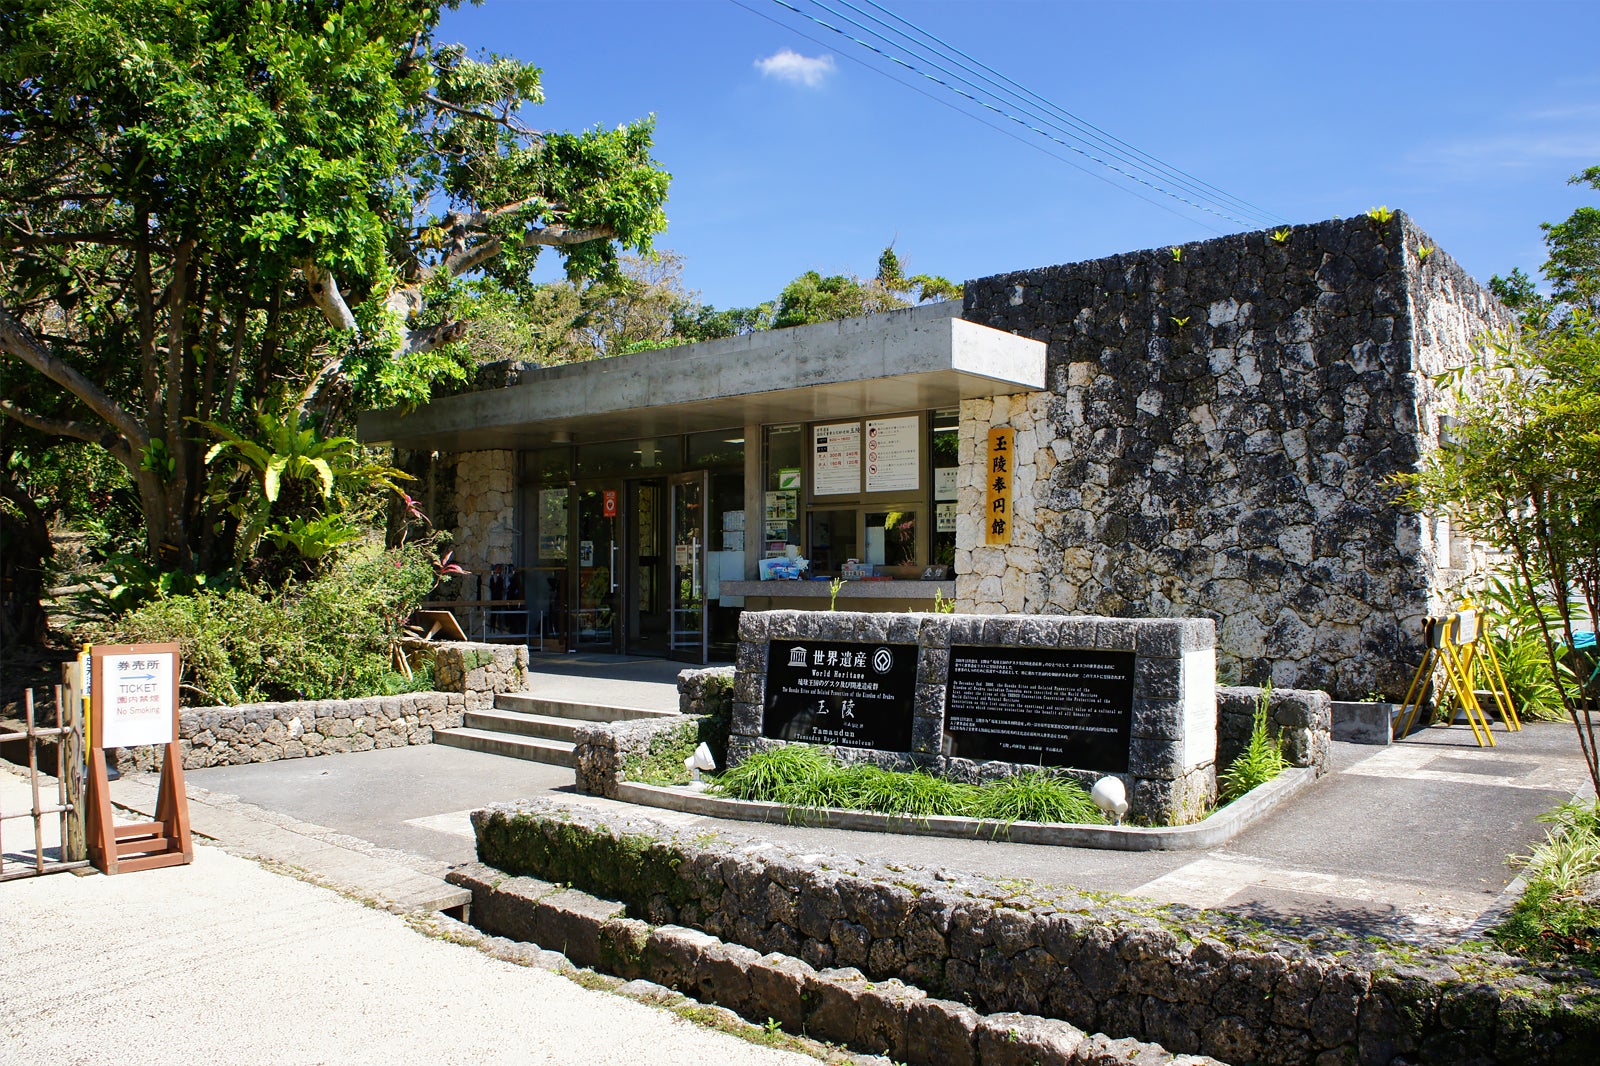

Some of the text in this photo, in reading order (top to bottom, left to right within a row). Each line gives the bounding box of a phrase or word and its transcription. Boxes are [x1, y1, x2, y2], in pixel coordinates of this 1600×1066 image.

[991, 435, 1007, 536] 玉陵奉円館
[813, 649, 867, 668] 世界遺産
[117, 660, 159, 671] 券売所
[812, 669, 865, 680] World Heritage
[119, 683, 158, 693] TICKET
[117, 695, 159, 704] 園内禁煙
[117, 706, 160, 715] No Smoking
[816, 699, 856, 719] 玉陵
[812, 726, 855, 737] Tamaudun
